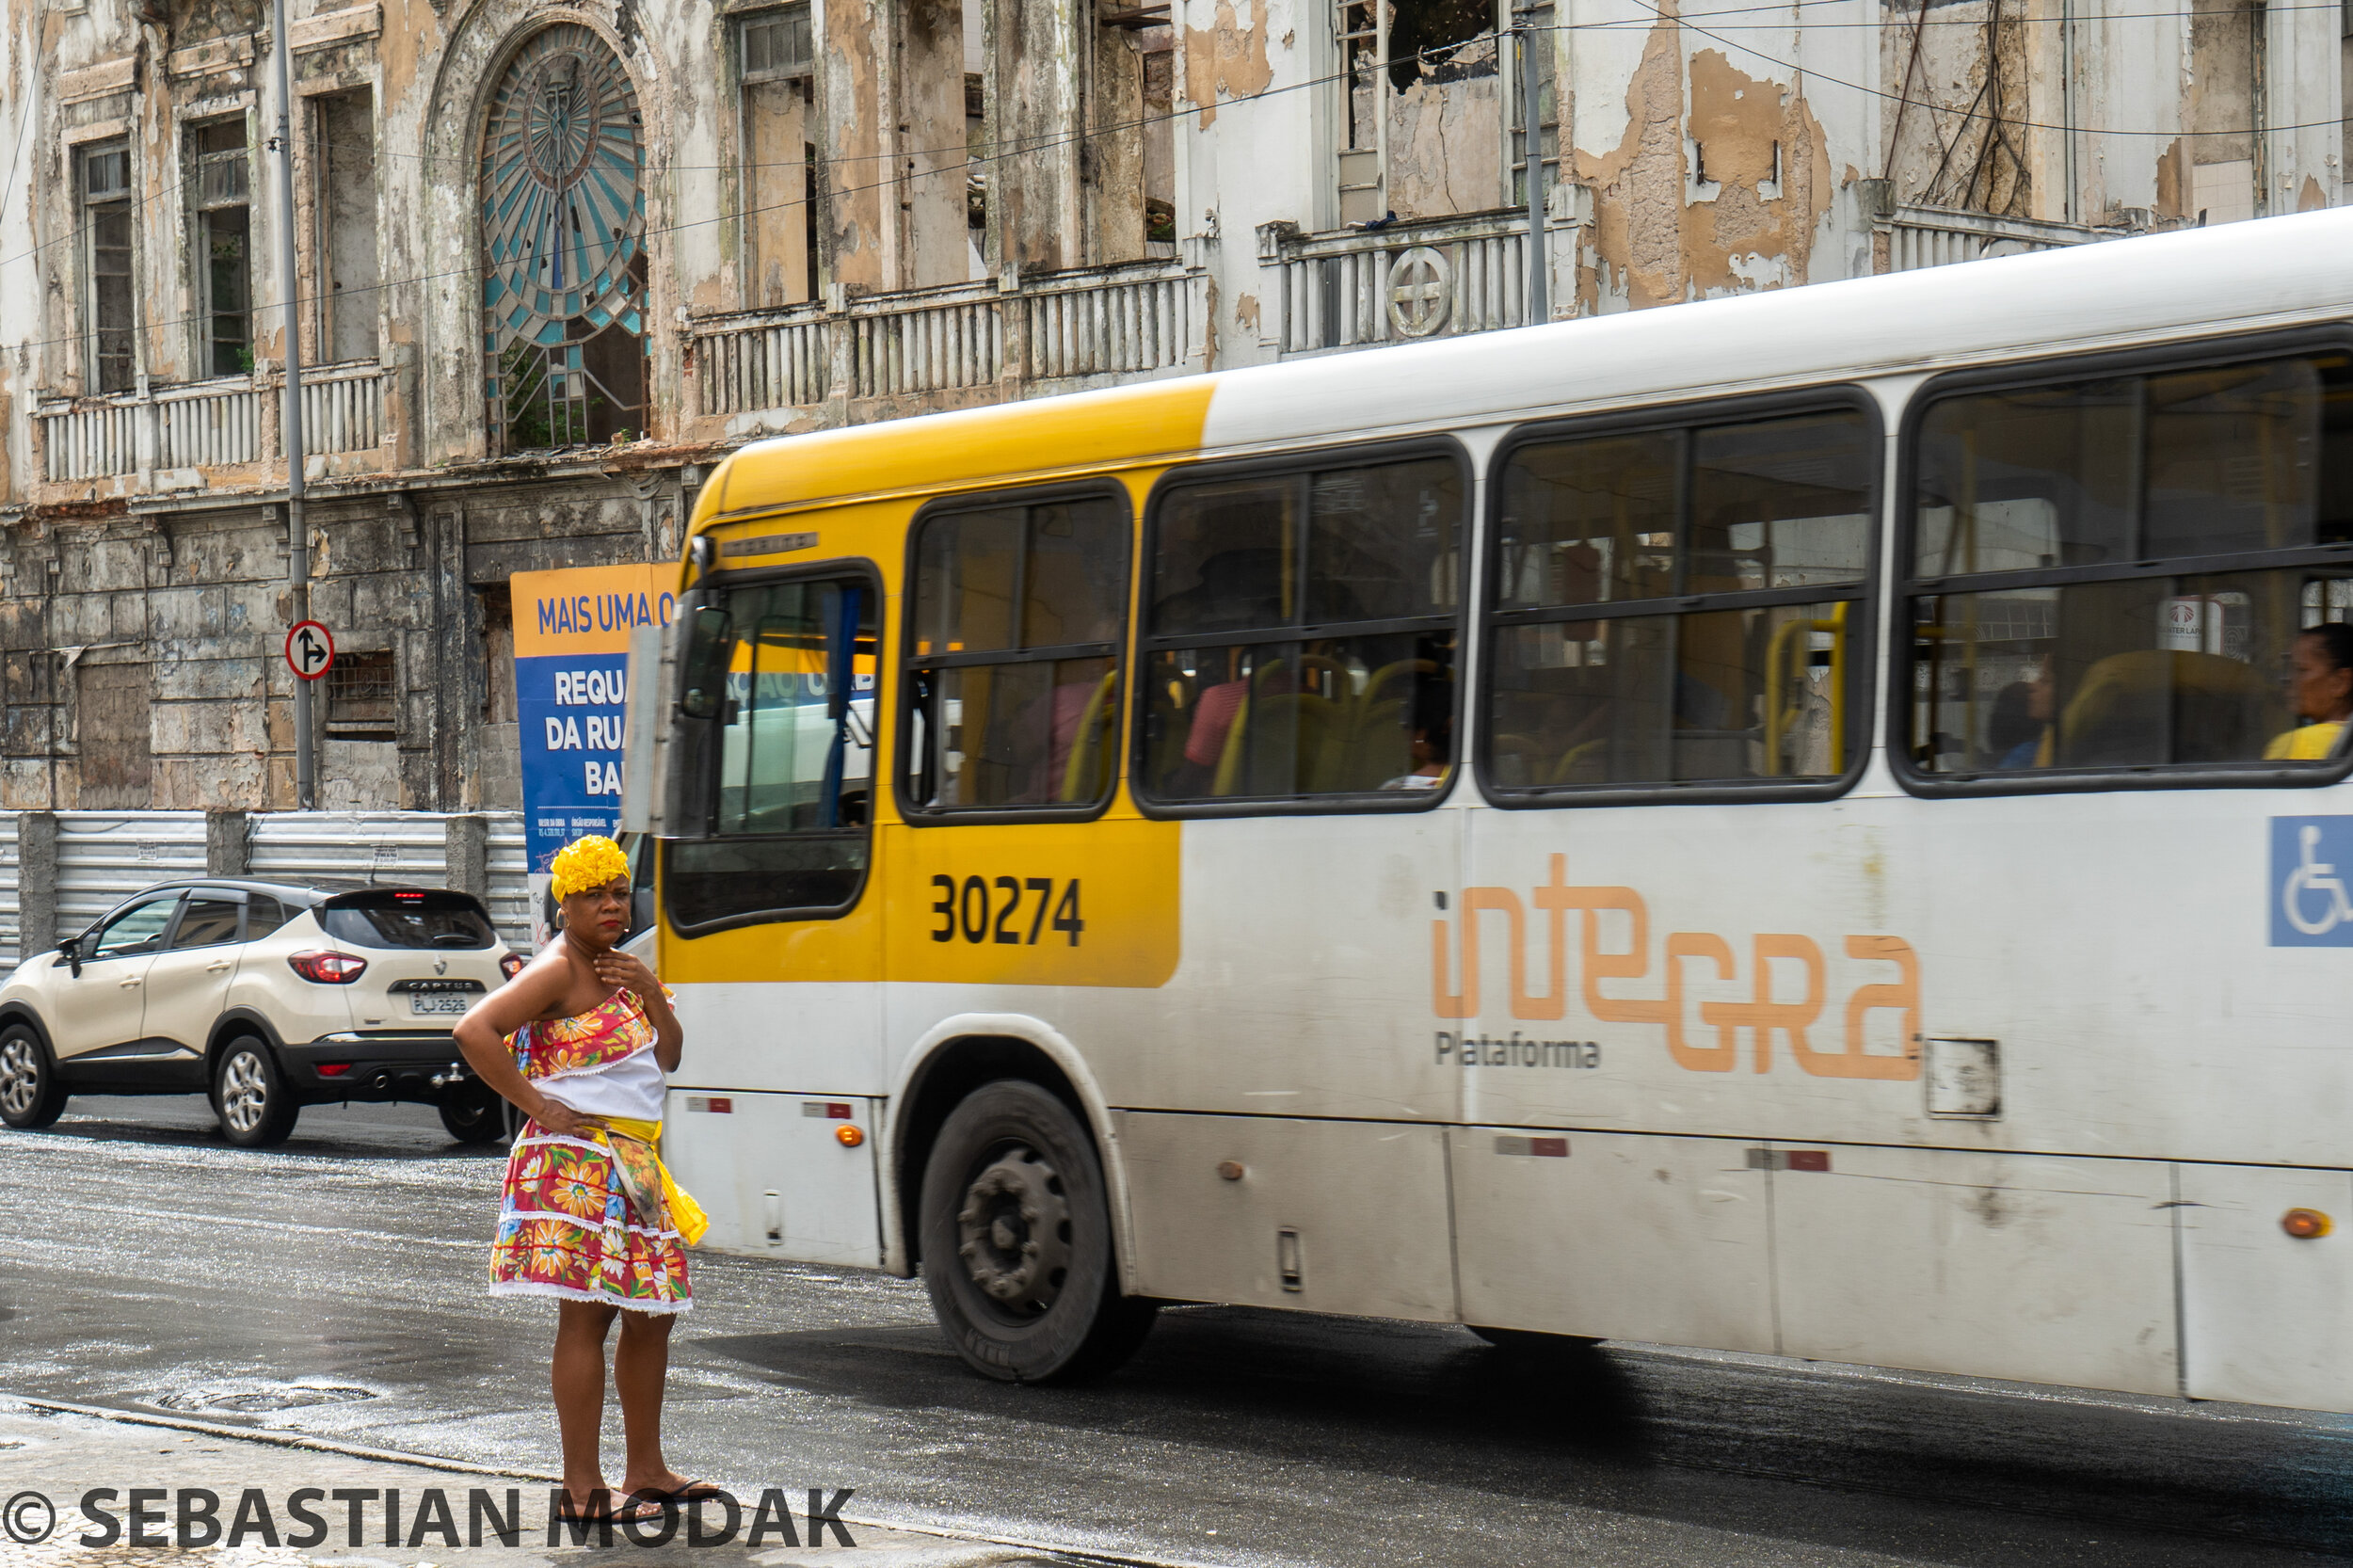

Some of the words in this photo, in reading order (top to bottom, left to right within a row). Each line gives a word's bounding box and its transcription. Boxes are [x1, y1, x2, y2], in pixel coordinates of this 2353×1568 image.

[537, 595, 593, 635] MAIS
[597, 592, 653, 632] UMA
[554, 669, 629, 705] REQU
[546, 716, 583, 750] DA
[586, 715, 627, 750] RU
[584, 760, 625, 795] BA
[931, 874, 1084, 947] 30274
[1435, 1030, 1601, 1069] Plataforma
